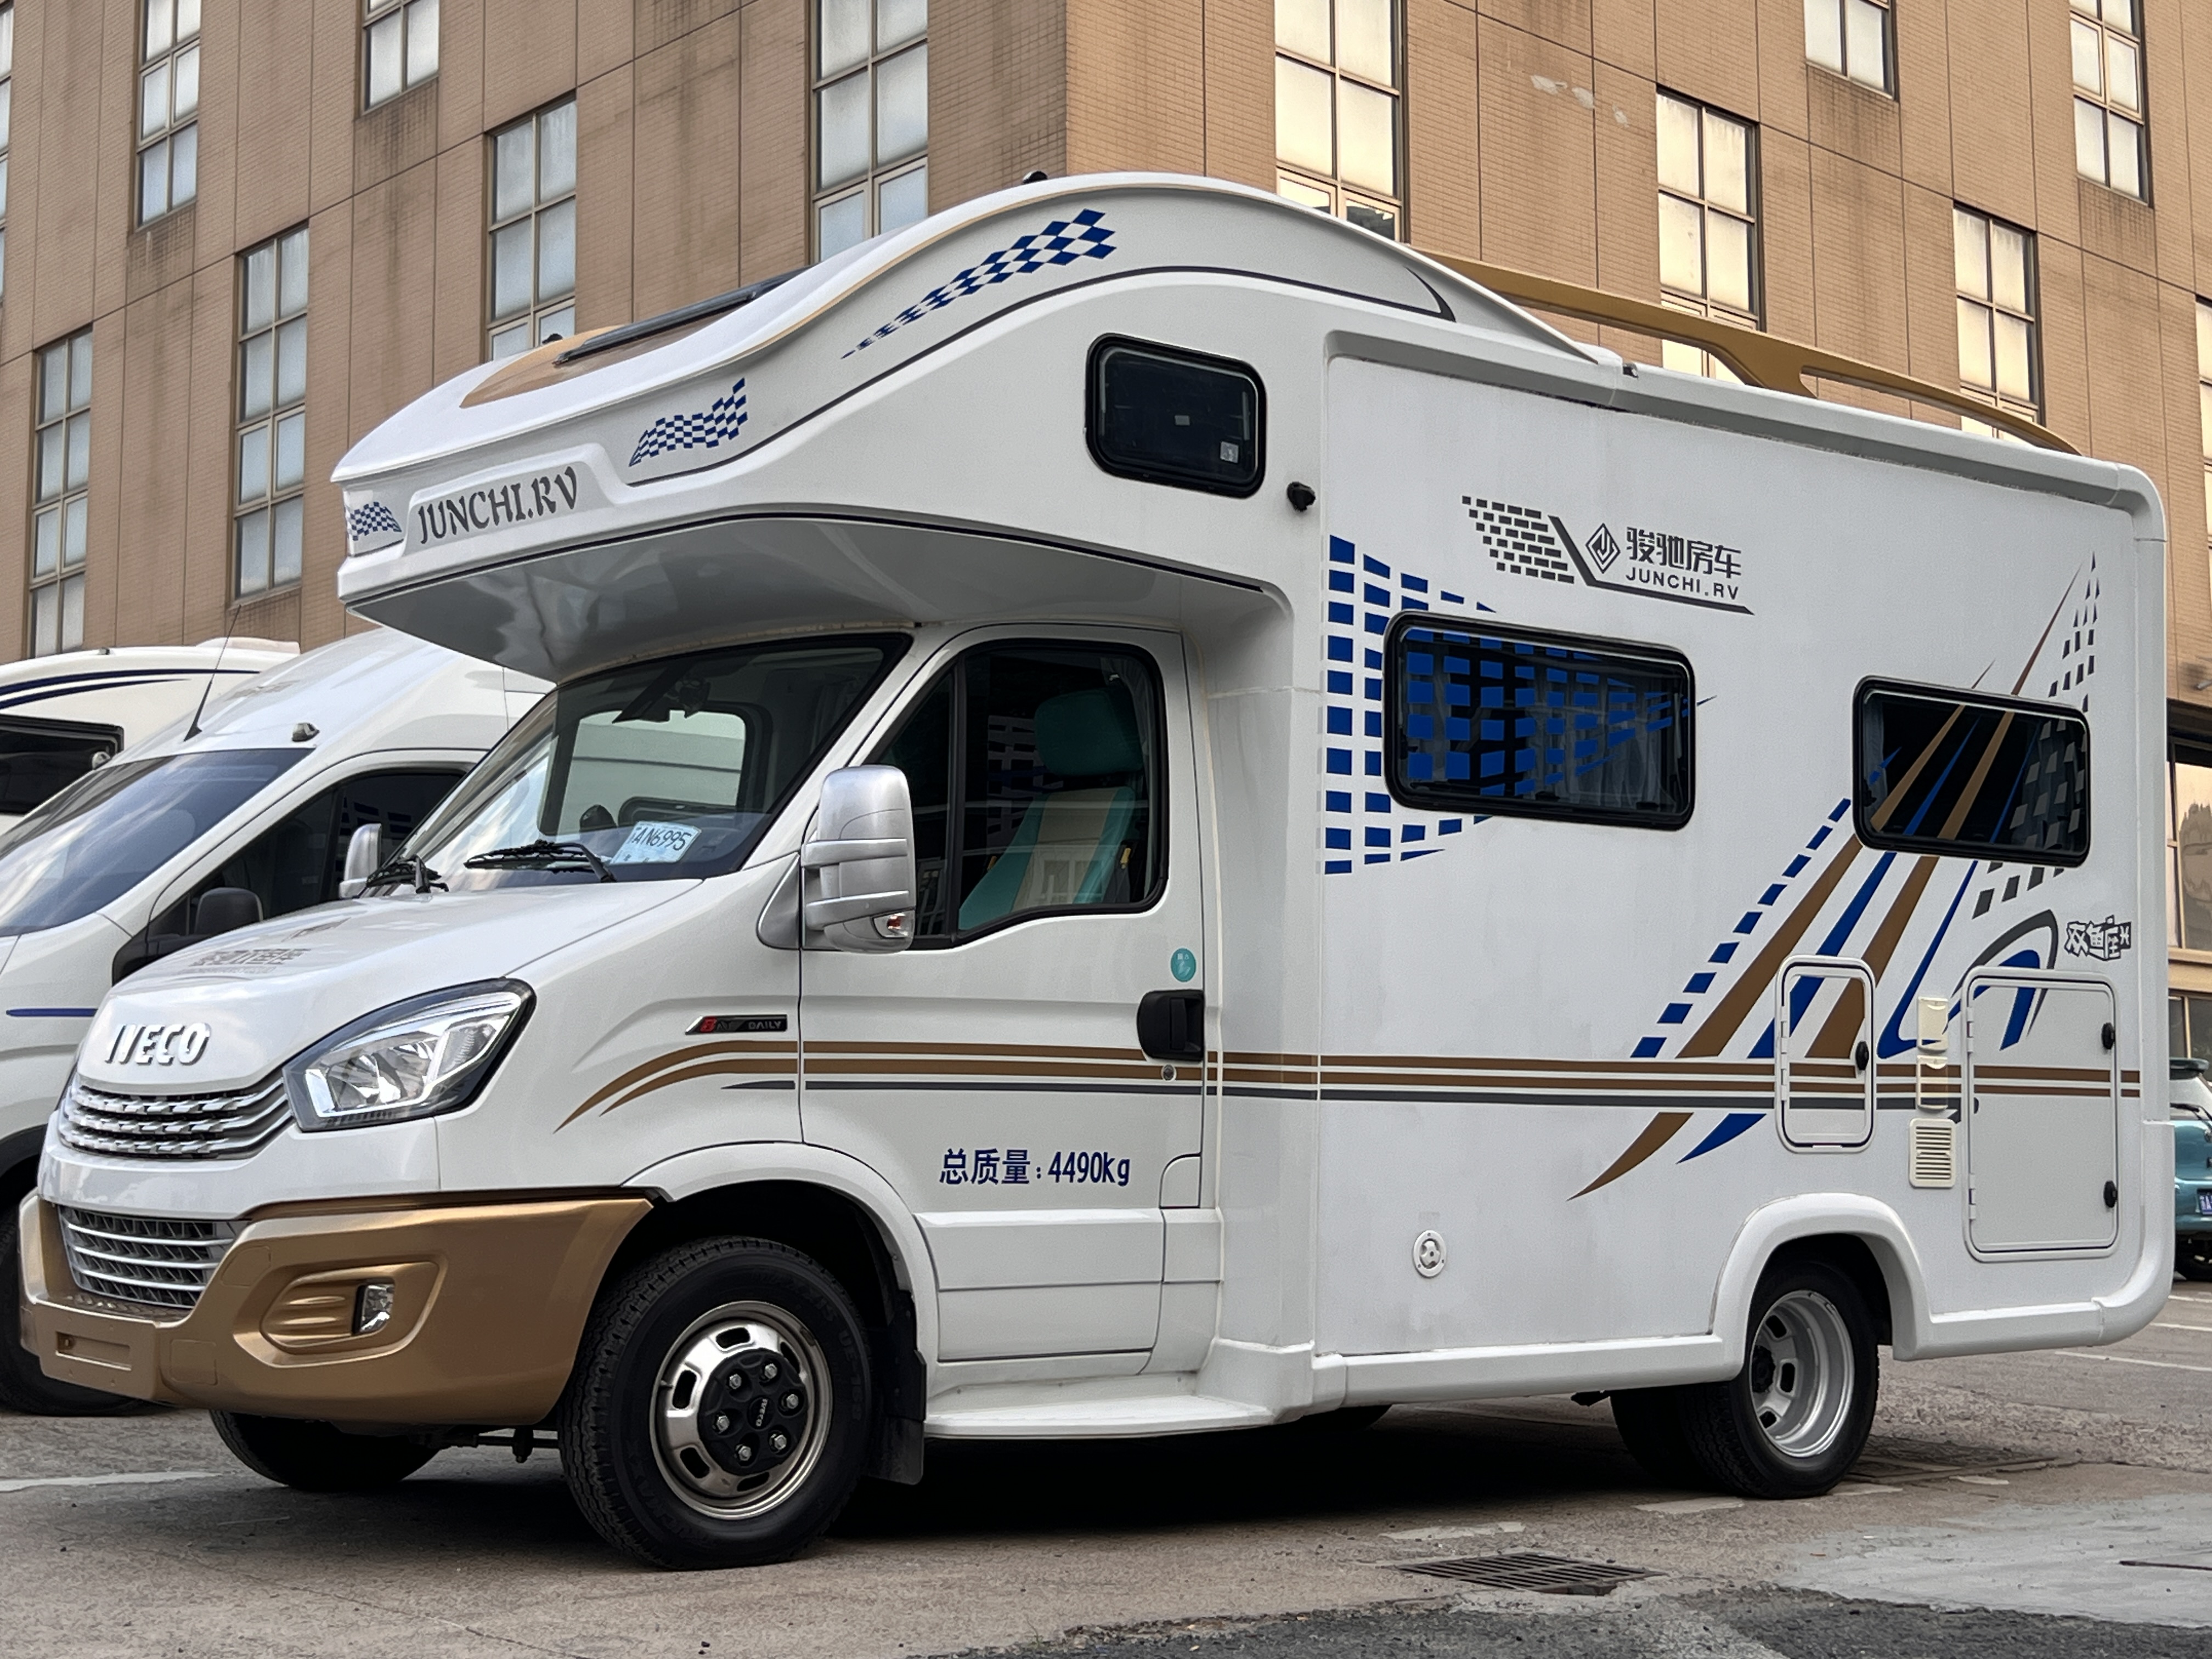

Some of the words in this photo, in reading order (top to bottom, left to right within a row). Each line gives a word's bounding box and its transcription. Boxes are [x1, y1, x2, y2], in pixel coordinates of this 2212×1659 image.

[417, 465, 578, 545] JUNCHI.RV
[1626, 526, 1742, 579] 骏驰房车
[1626, 567, 1739, 600] JUNCHI.RV
[628, 827, 692, 851] AN6995
[105, 1023, 211, 1065] IVECO
[755, 1398, 768, 1427] IVECO
